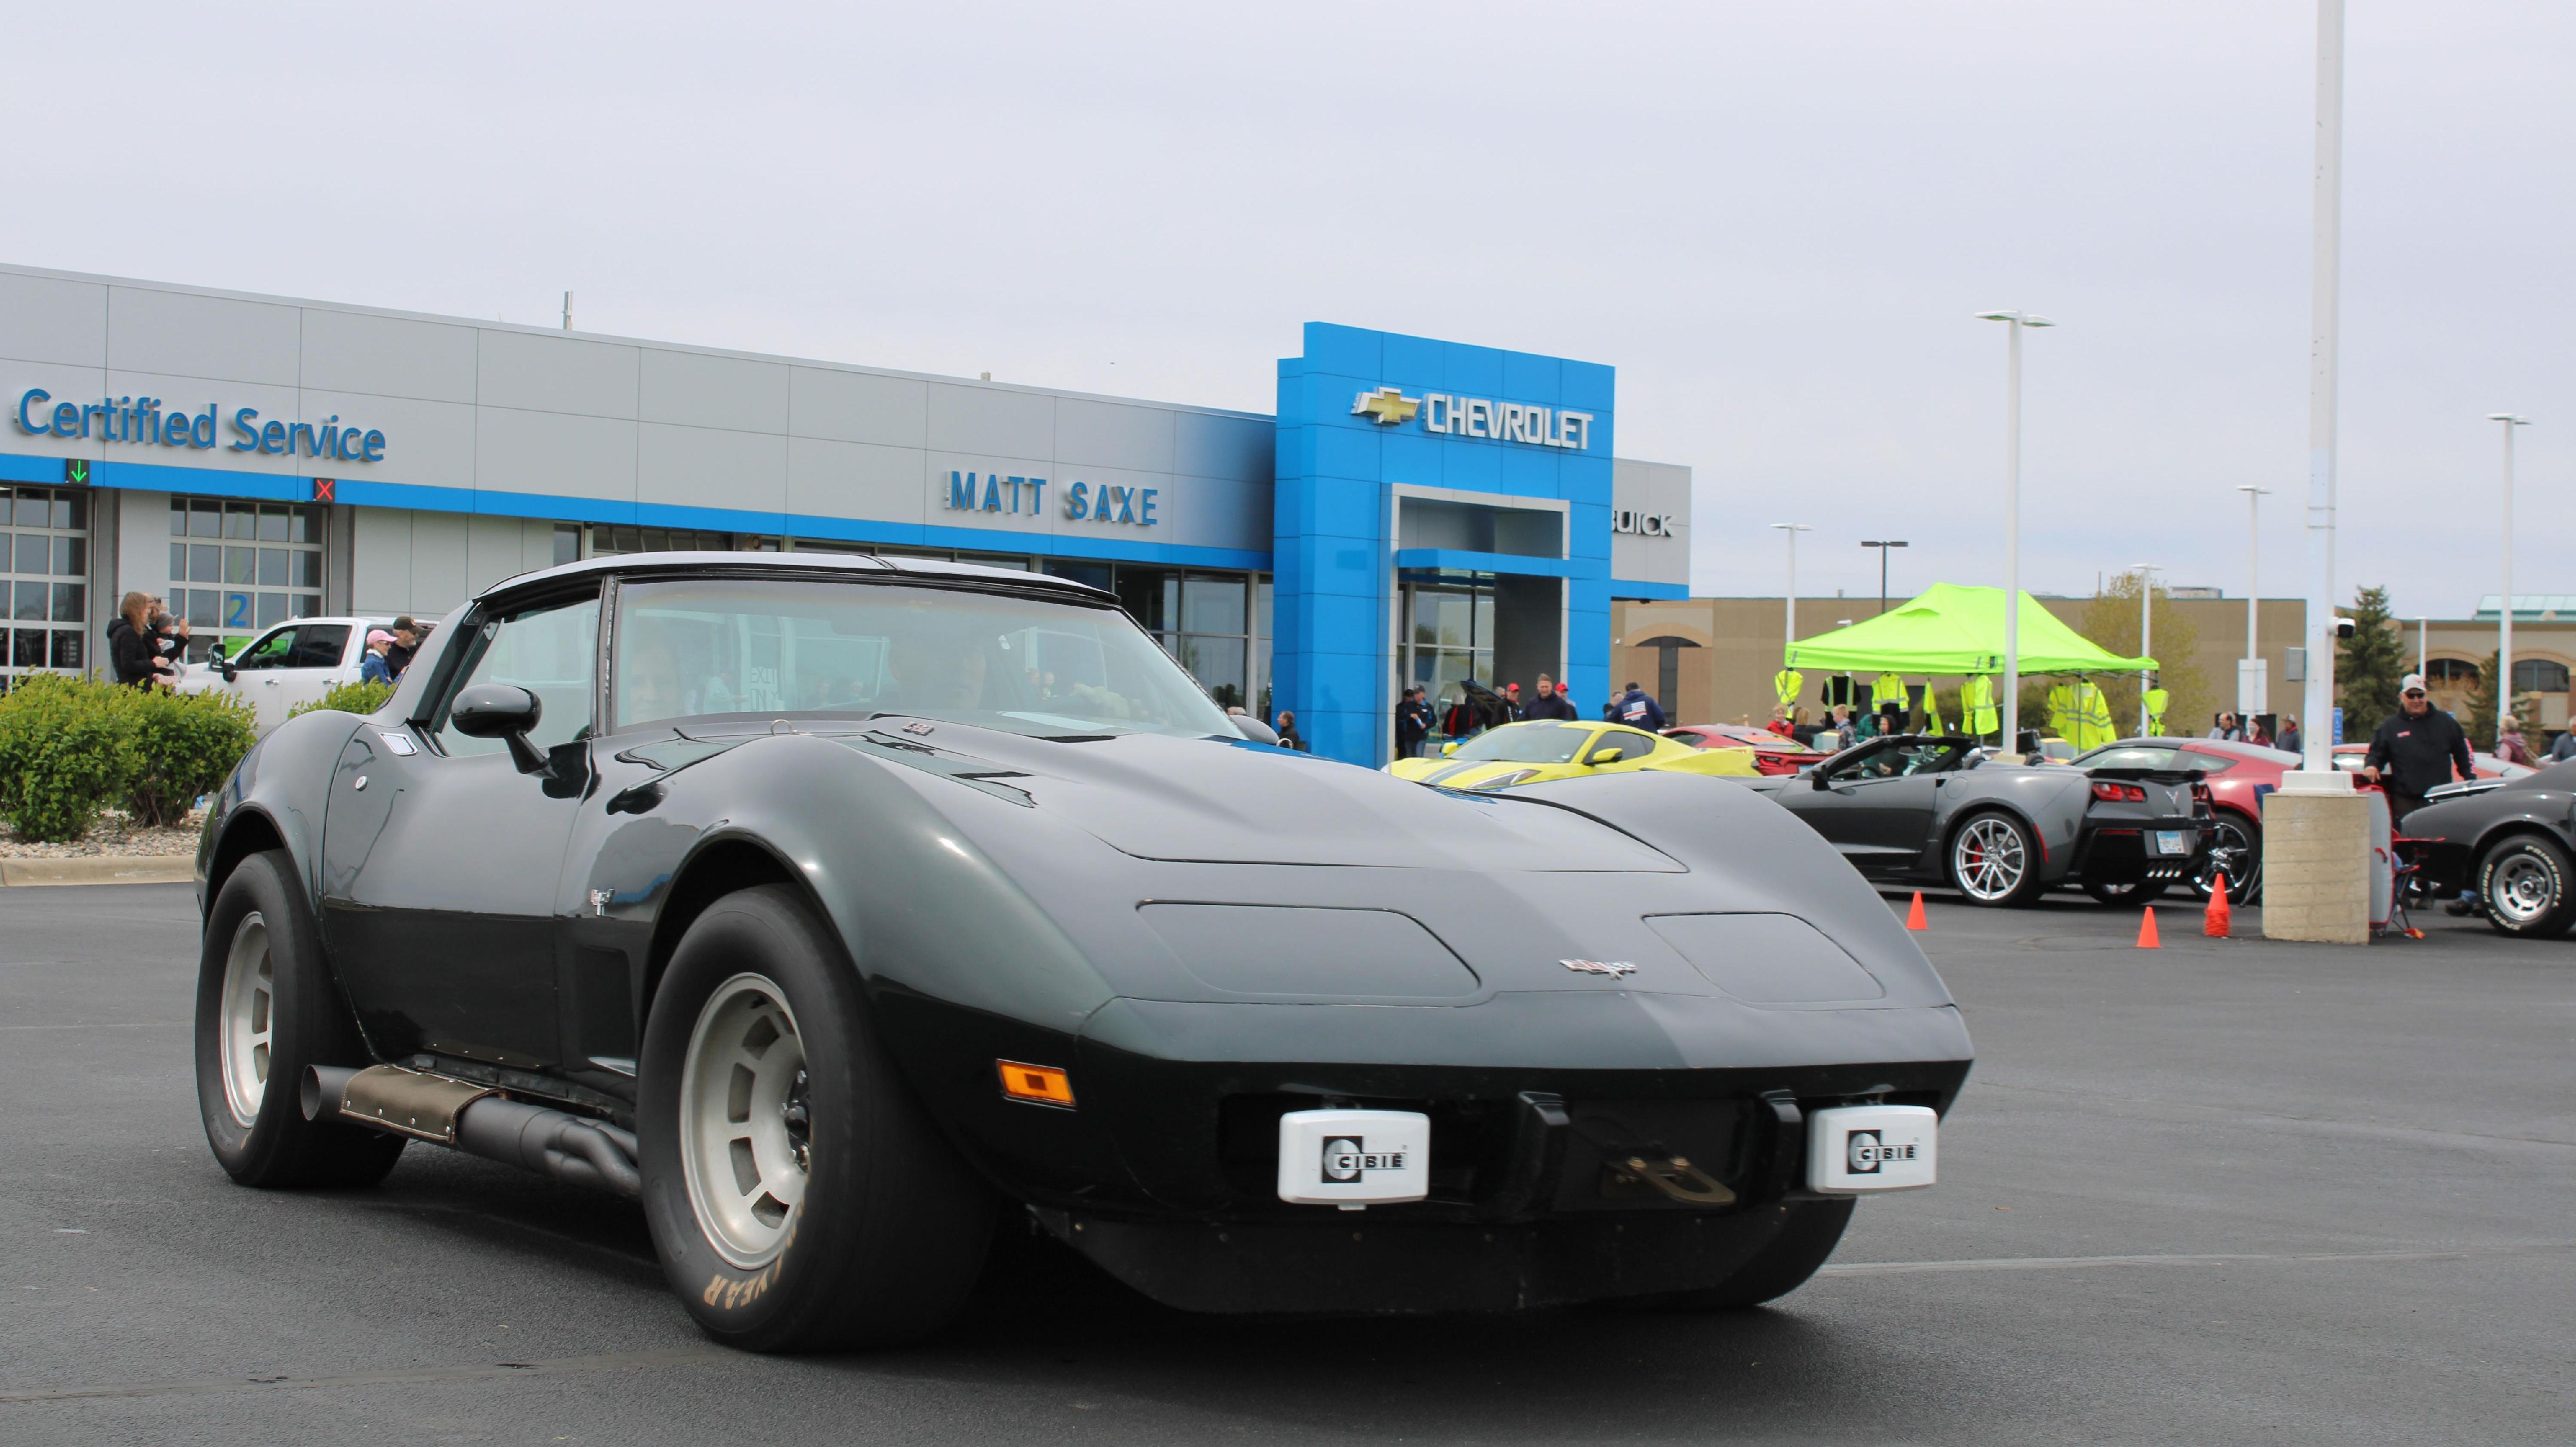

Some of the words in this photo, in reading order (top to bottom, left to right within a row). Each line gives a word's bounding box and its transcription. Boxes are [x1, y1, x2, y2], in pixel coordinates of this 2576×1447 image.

[18, 388, 217, 449] Certified
[234, 407, 386, 462] Service
[1425, 393, 1594, 450] CHEVROLET
[949, 470, 1047, 515] MATT
[1069, 482, 1158, 525] SAXE
[229, 594, 247, 627] 2
